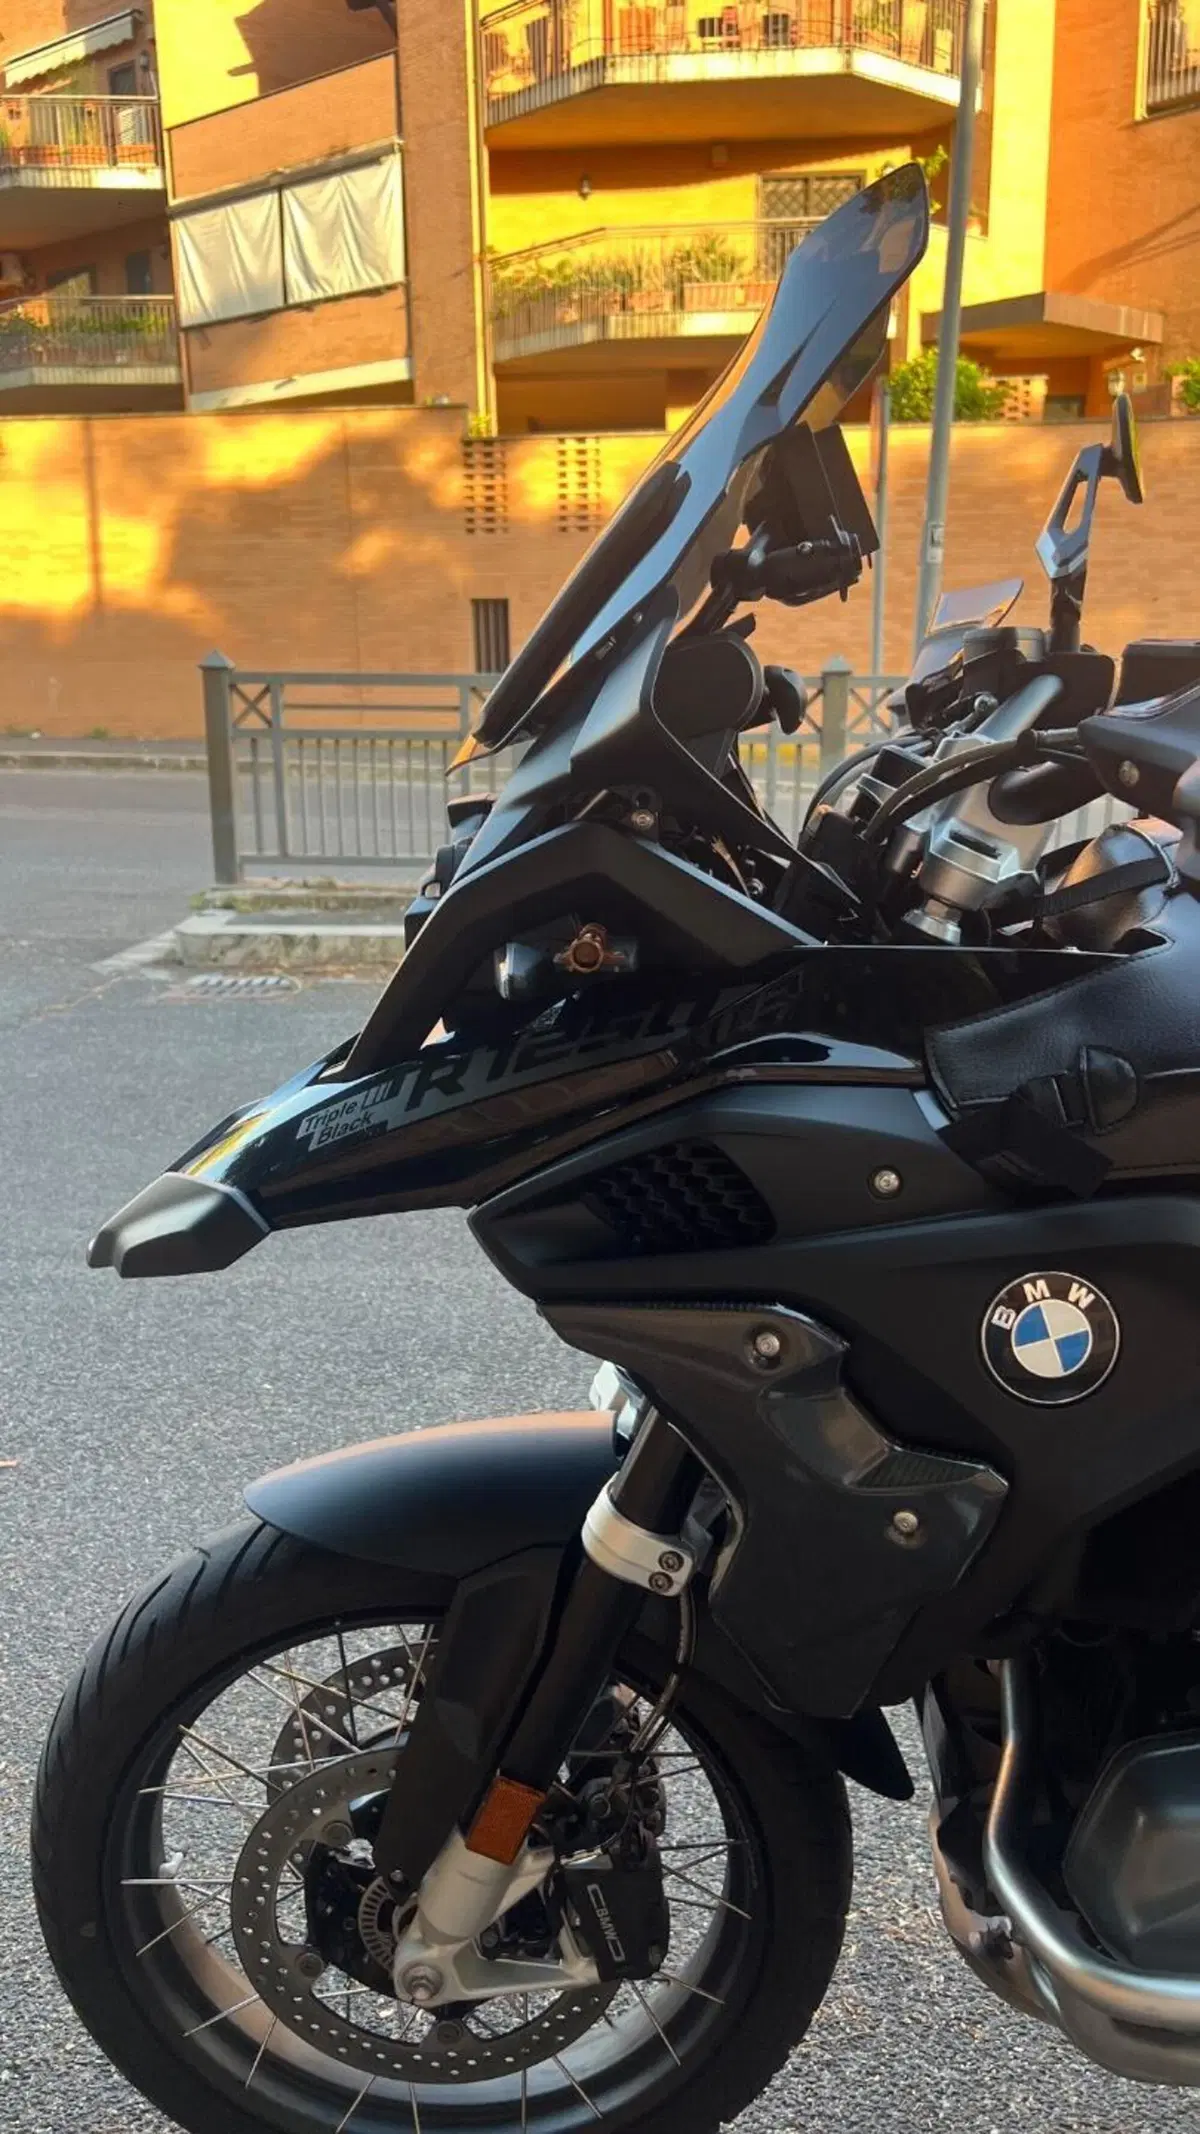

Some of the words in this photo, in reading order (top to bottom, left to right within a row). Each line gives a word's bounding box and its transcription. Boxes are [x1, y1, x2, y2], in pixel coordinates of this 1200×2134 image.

[305, 1101, 358, 1132] Triple
[318, 1111, 375, 1144] Black
[991, 1279, 1096, 1330] BMW
[595, 1908, 620, 1940] BMW
